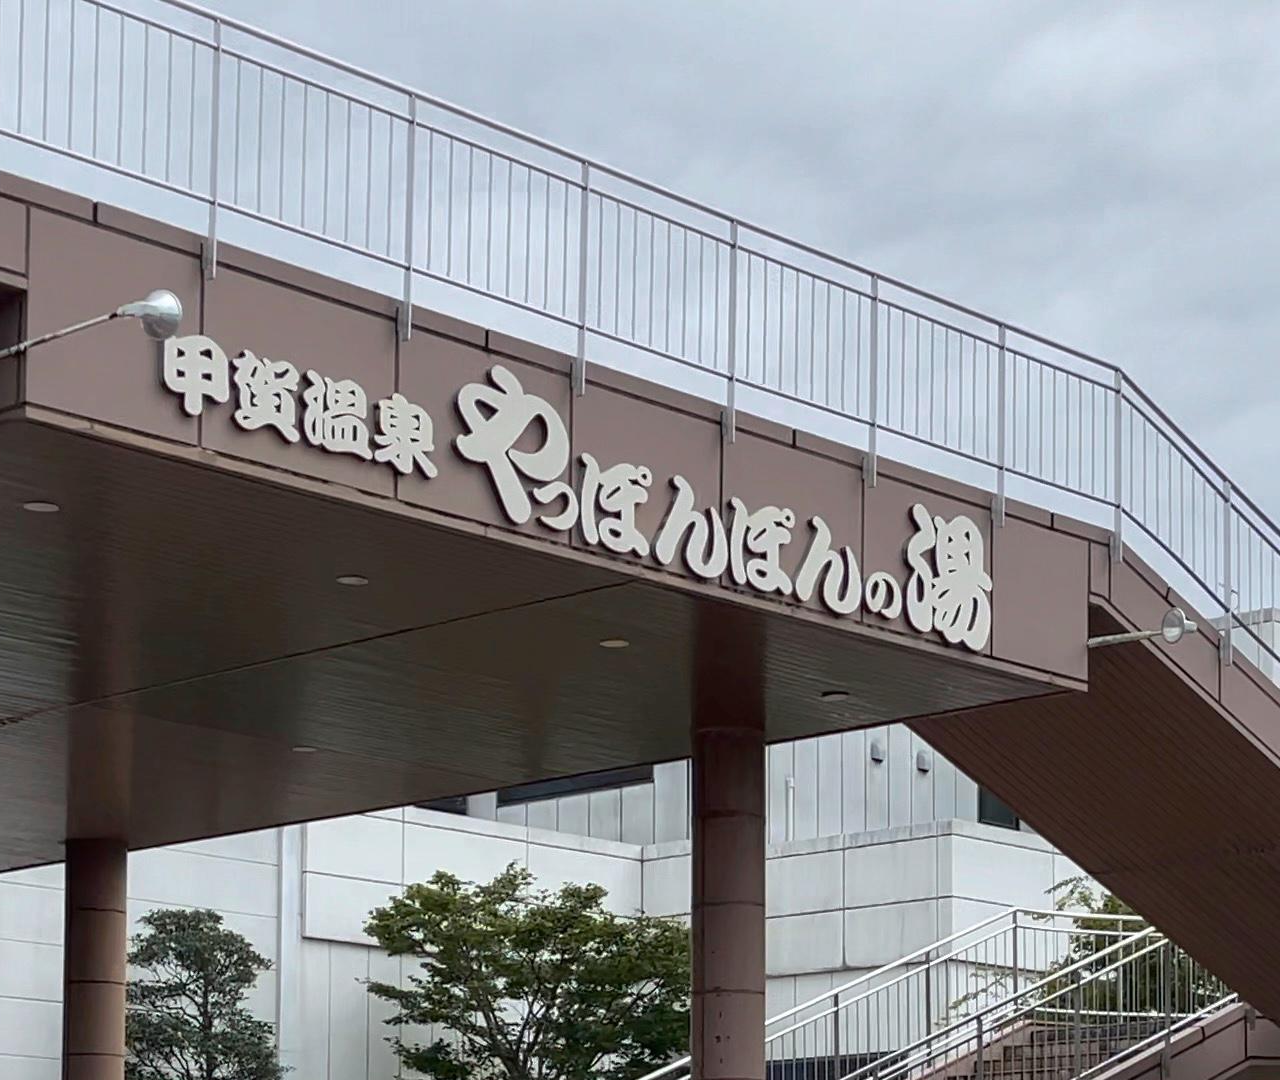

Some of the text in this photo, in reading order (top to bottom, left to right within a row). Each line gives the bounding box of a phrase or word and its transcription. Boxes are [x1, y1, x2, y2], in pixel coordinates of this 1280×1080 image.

[162, 336, 993, 652] 甲賀温泉 やっぽんぽんの湯
